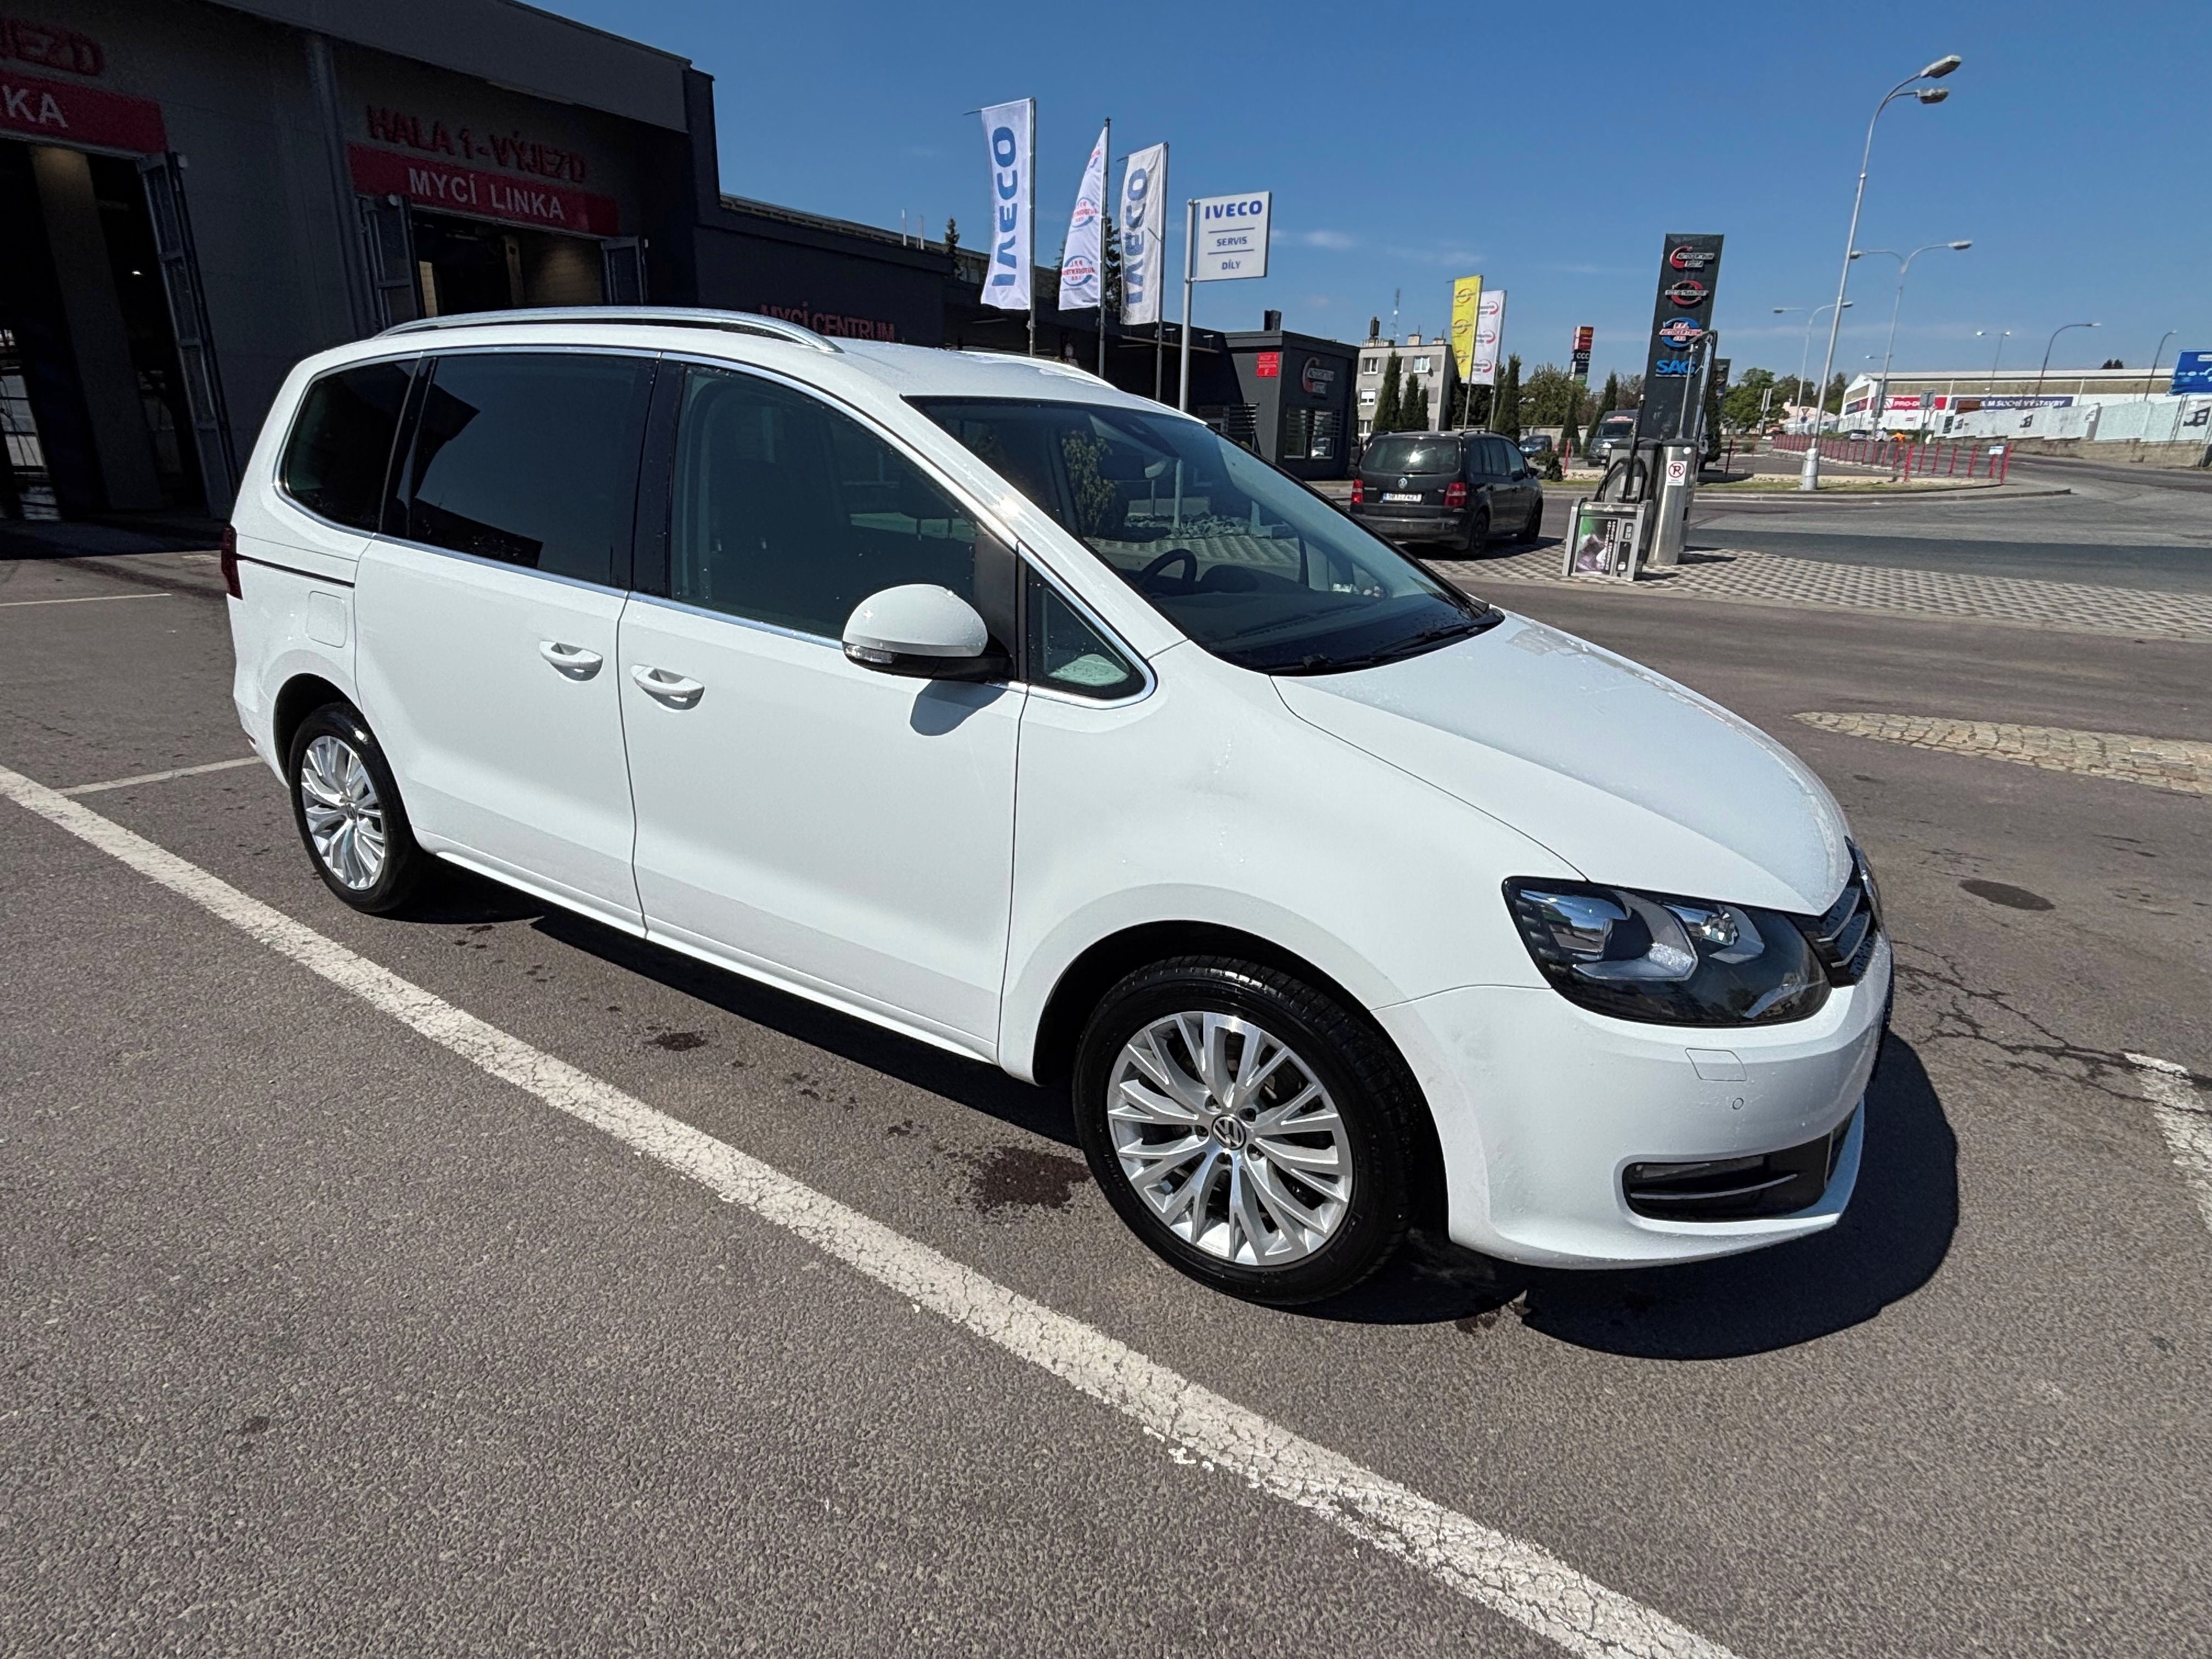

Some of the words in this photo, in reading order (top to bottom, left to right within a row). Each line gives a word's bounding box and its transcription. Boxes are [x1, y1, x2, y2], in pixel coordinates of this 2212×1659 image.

[367, 104, 455, 156] HALA
[409, 167, 477, 204] MYCÍ
[490, 184, 566, 221] LINKA
[1205, 200, 1262, 219] IVECO
[1217, 236, 1247, 247] SERVIS
[1221, 259, 1241, 270] DÍLY
[812, 312, 895, 341] CENTRUM
